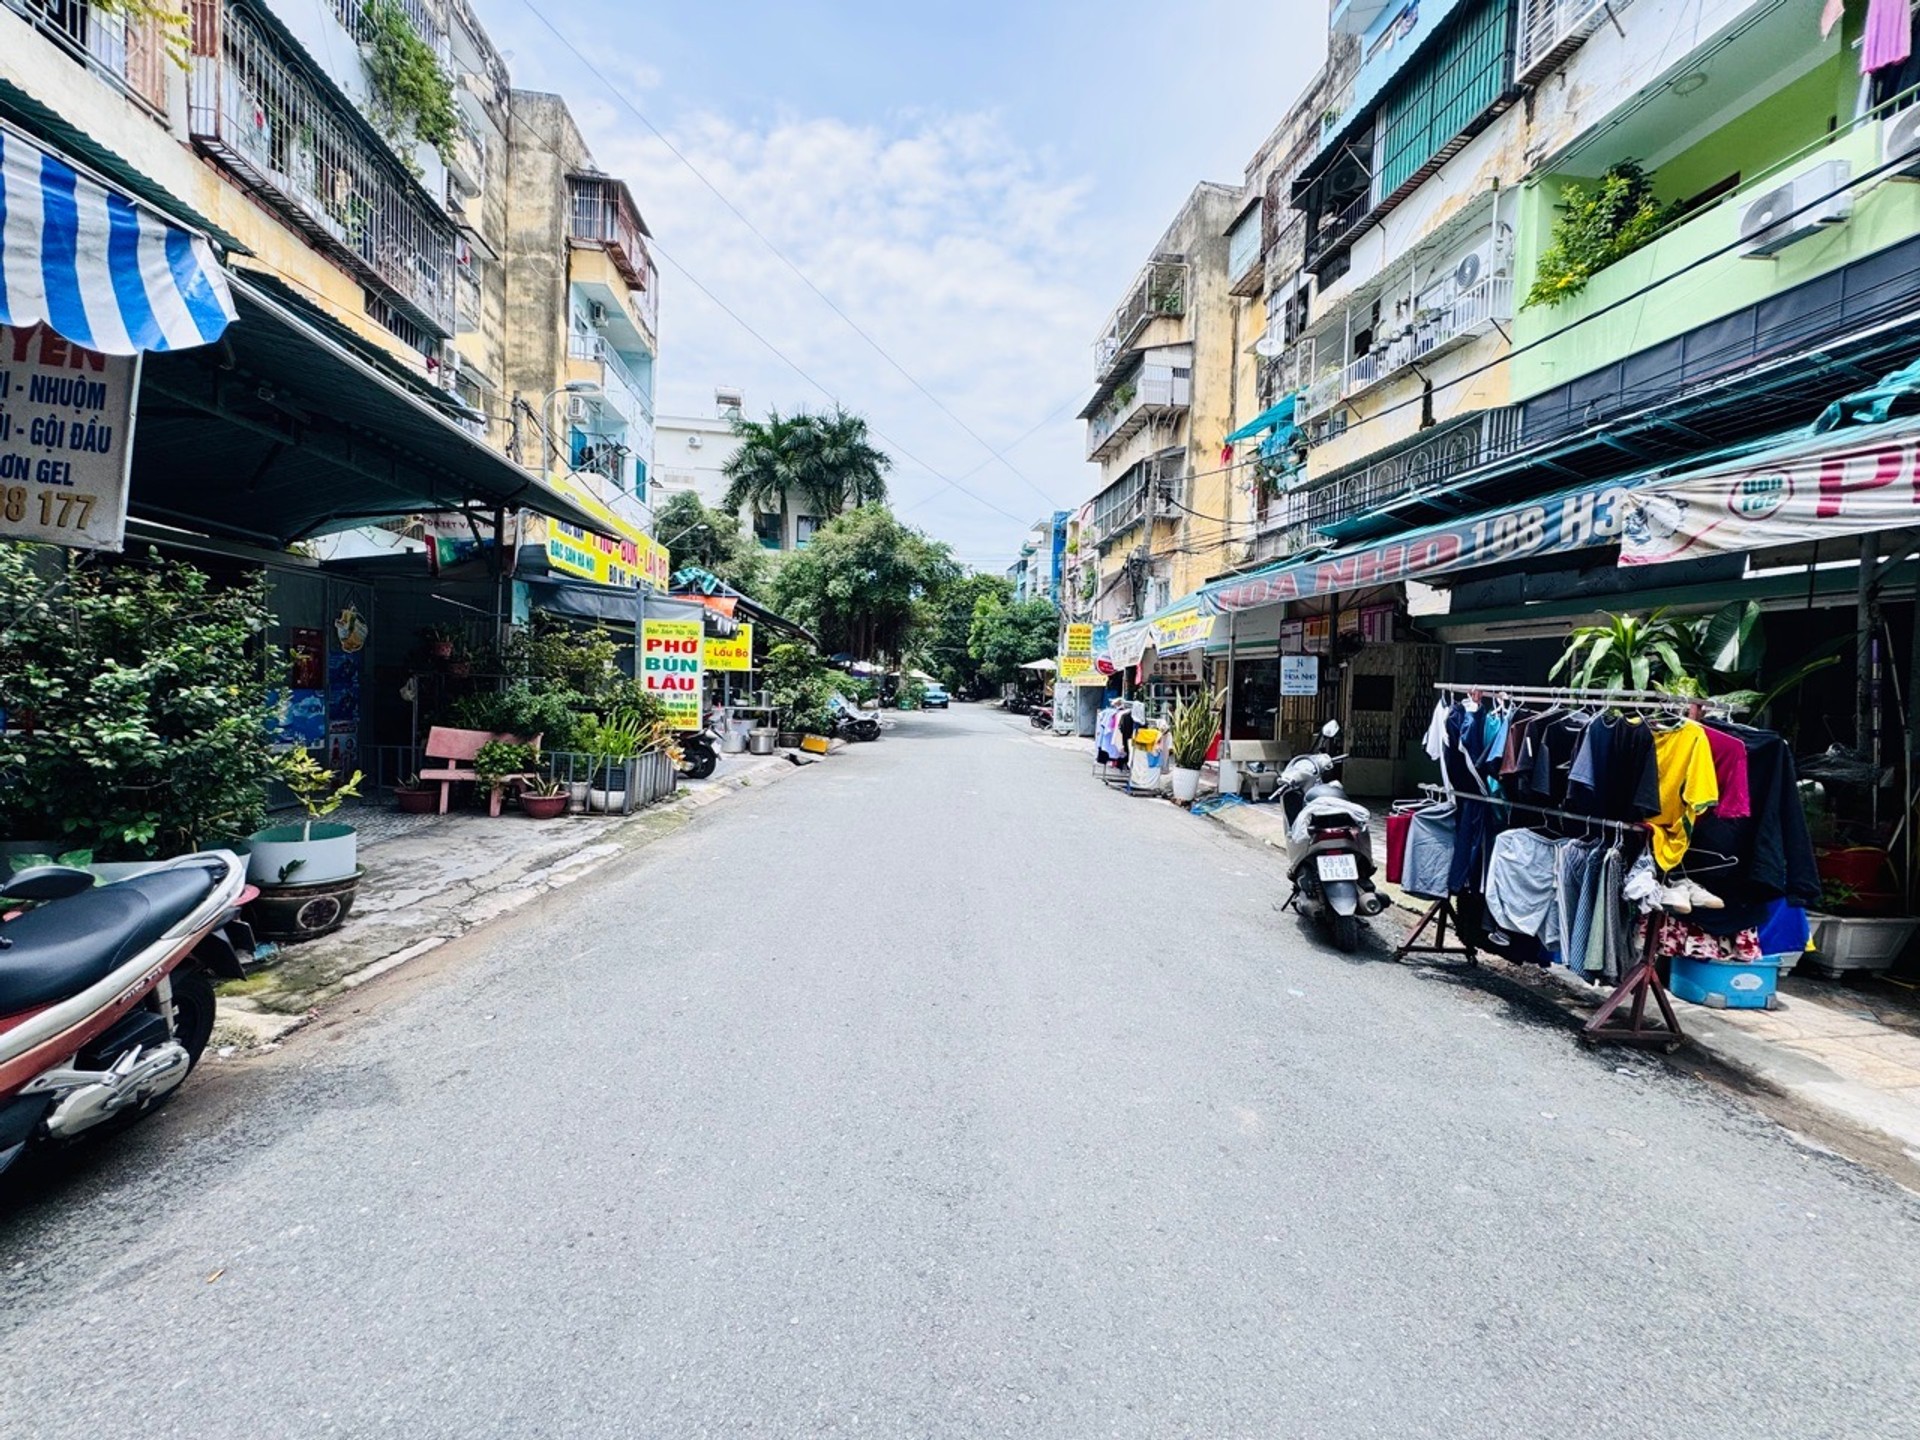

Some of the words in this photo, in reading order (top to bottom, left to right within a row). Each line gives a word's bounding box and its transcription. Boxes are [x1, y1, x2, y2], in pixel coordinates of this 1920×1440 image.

[30, 374, 106, 414] NHUỘM
[31, 413, 65, 453] GỘI
[70, 415, 112, 454] ĐẦU
[36, 459, 74, 487] GEL
[1815, 440, 1920, 518] P
[38, 490, 98, 530] 177
[1218, 573, 1299, 610] HOA
[1471, 506, 1545, 560] 108
[1560, 486, 1628, 543] H3
[645, 655, 698, 673] BÚN
[646, 636, 698, 654] PHỞ
